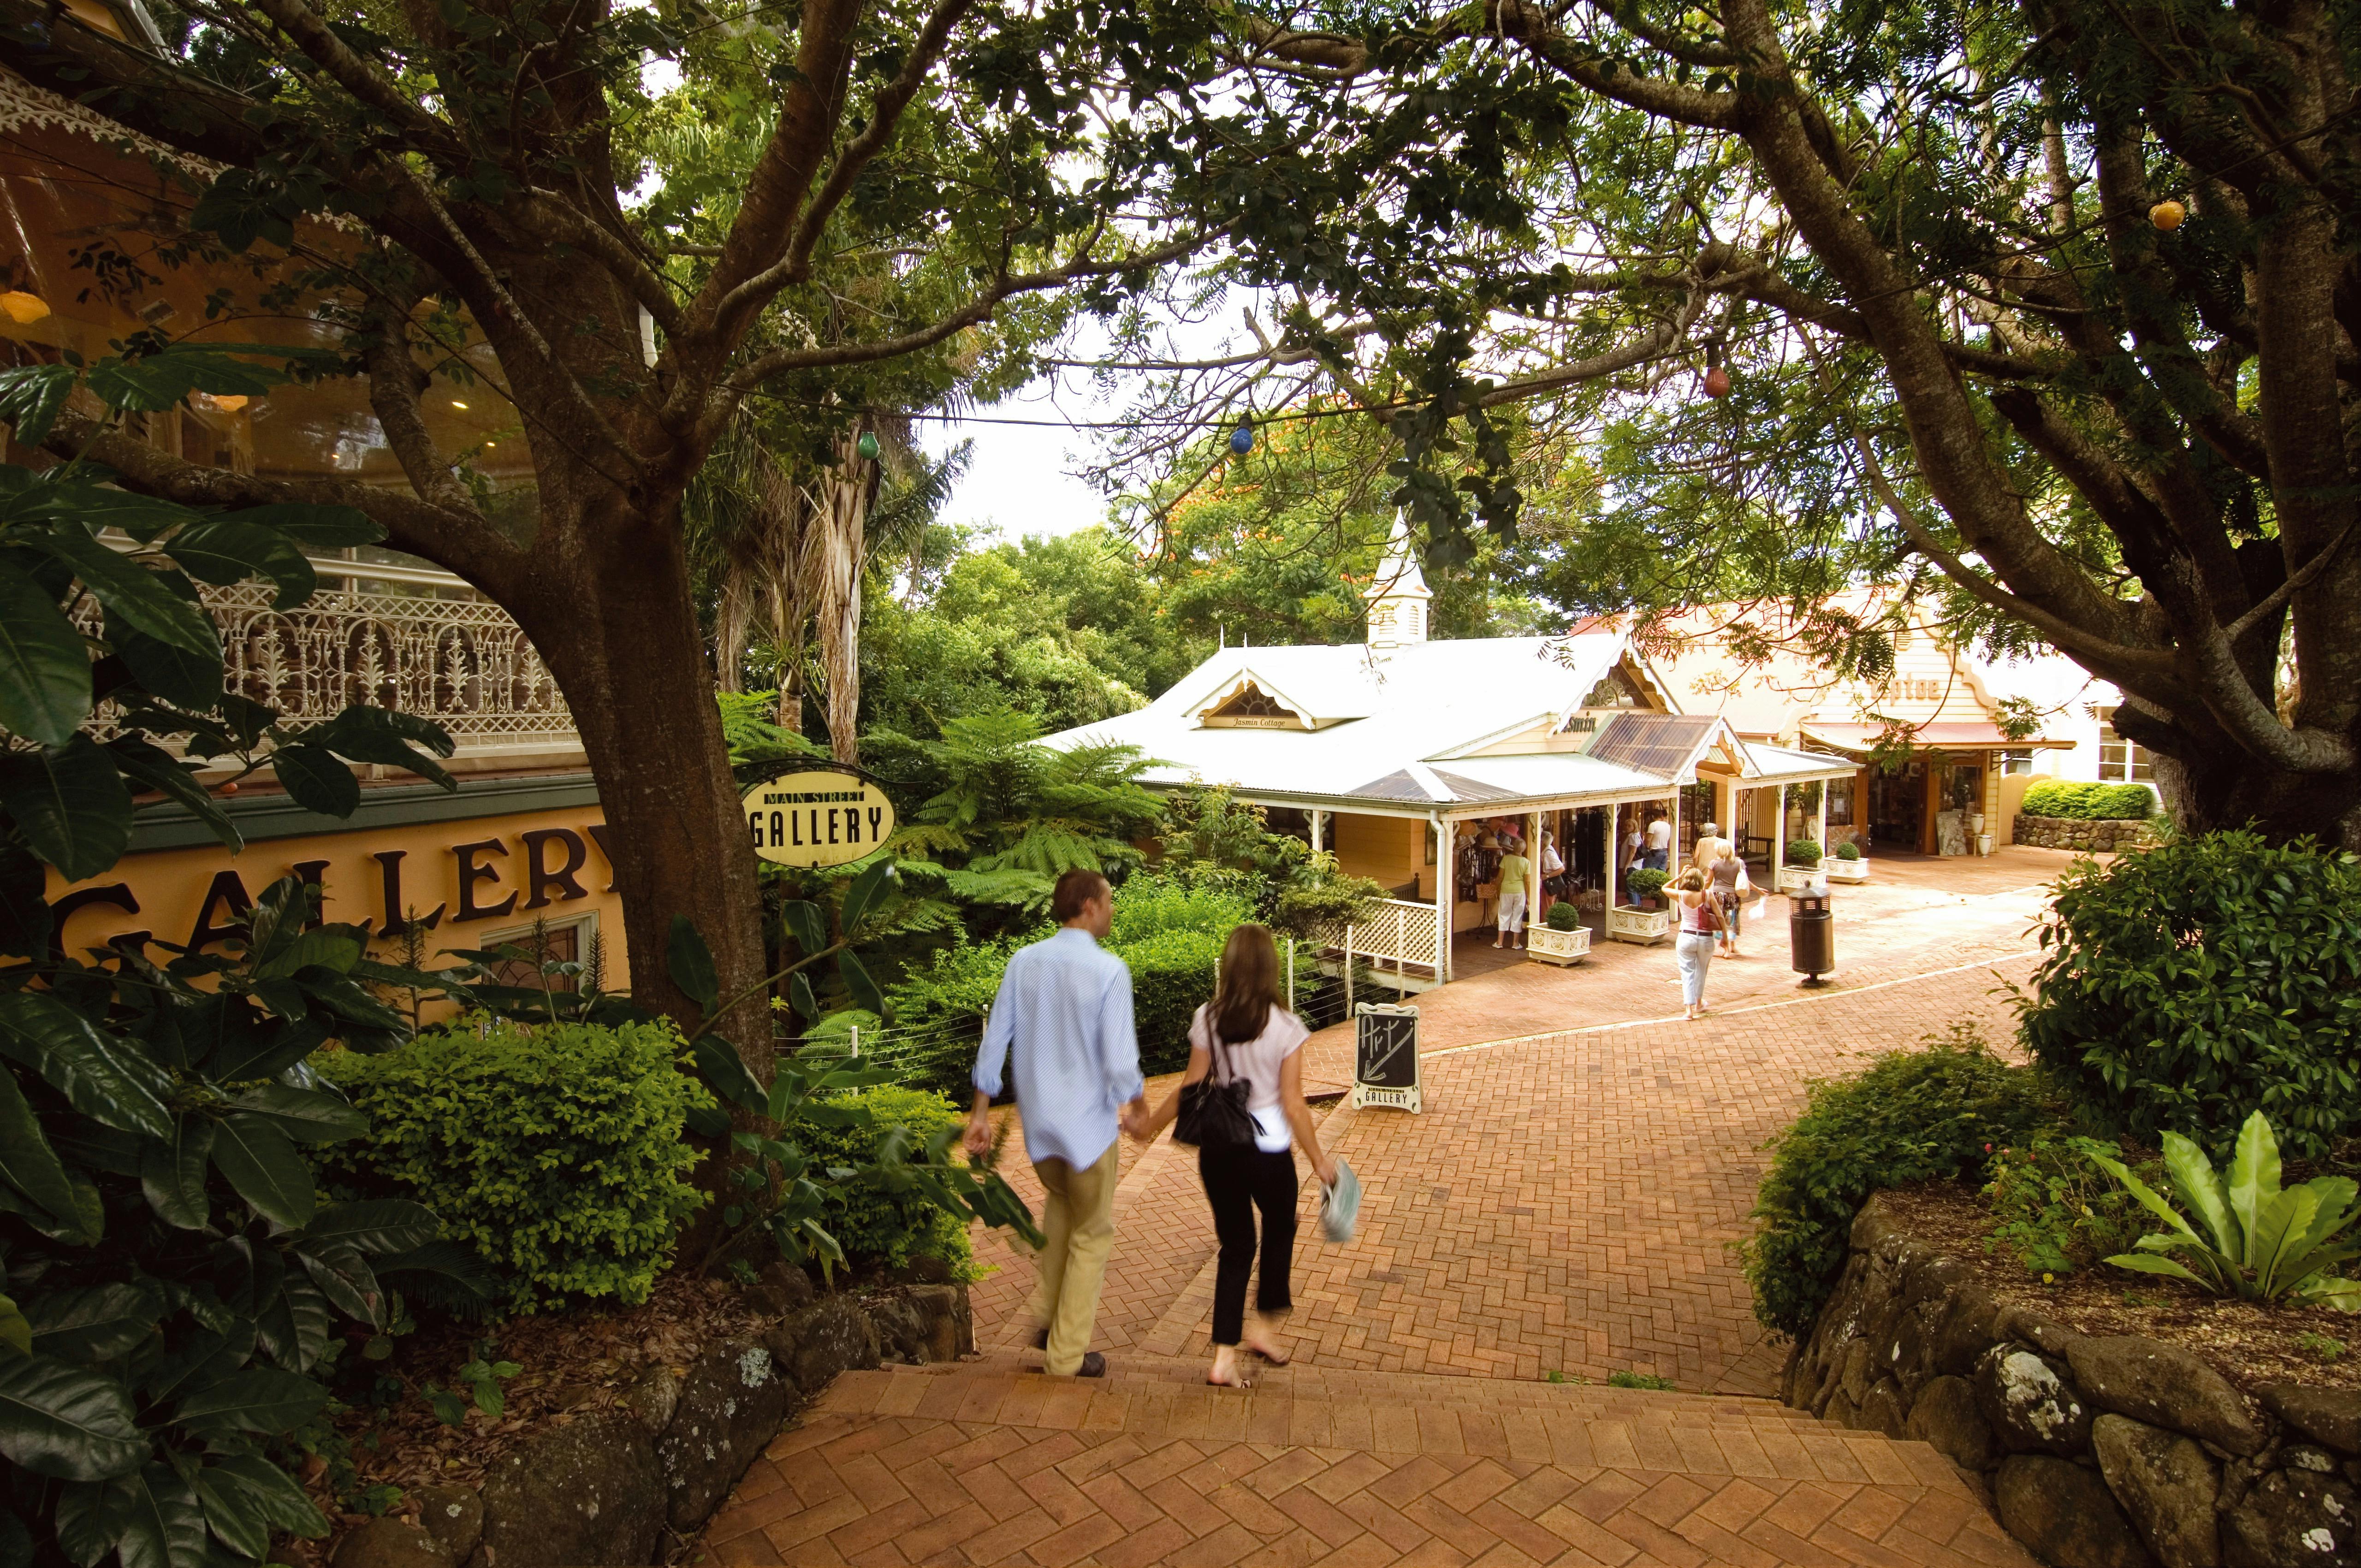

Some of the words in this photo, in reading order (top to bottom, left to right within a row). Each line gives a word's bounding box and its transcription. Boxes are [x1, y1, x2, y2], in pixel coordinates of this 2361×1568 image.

[1234, 718, 1258, 726] Jasmin
[1260, 718, 1286, 728] Cottage
[768, 793, 805, 804] MAIN
[812, 792, 863, 803] STREET
[749, 807, 881, 847] GALLERY
[1360, 1015, 1400, 1059] Art
[1366, 1091, 1407, 1104] GALLERY
